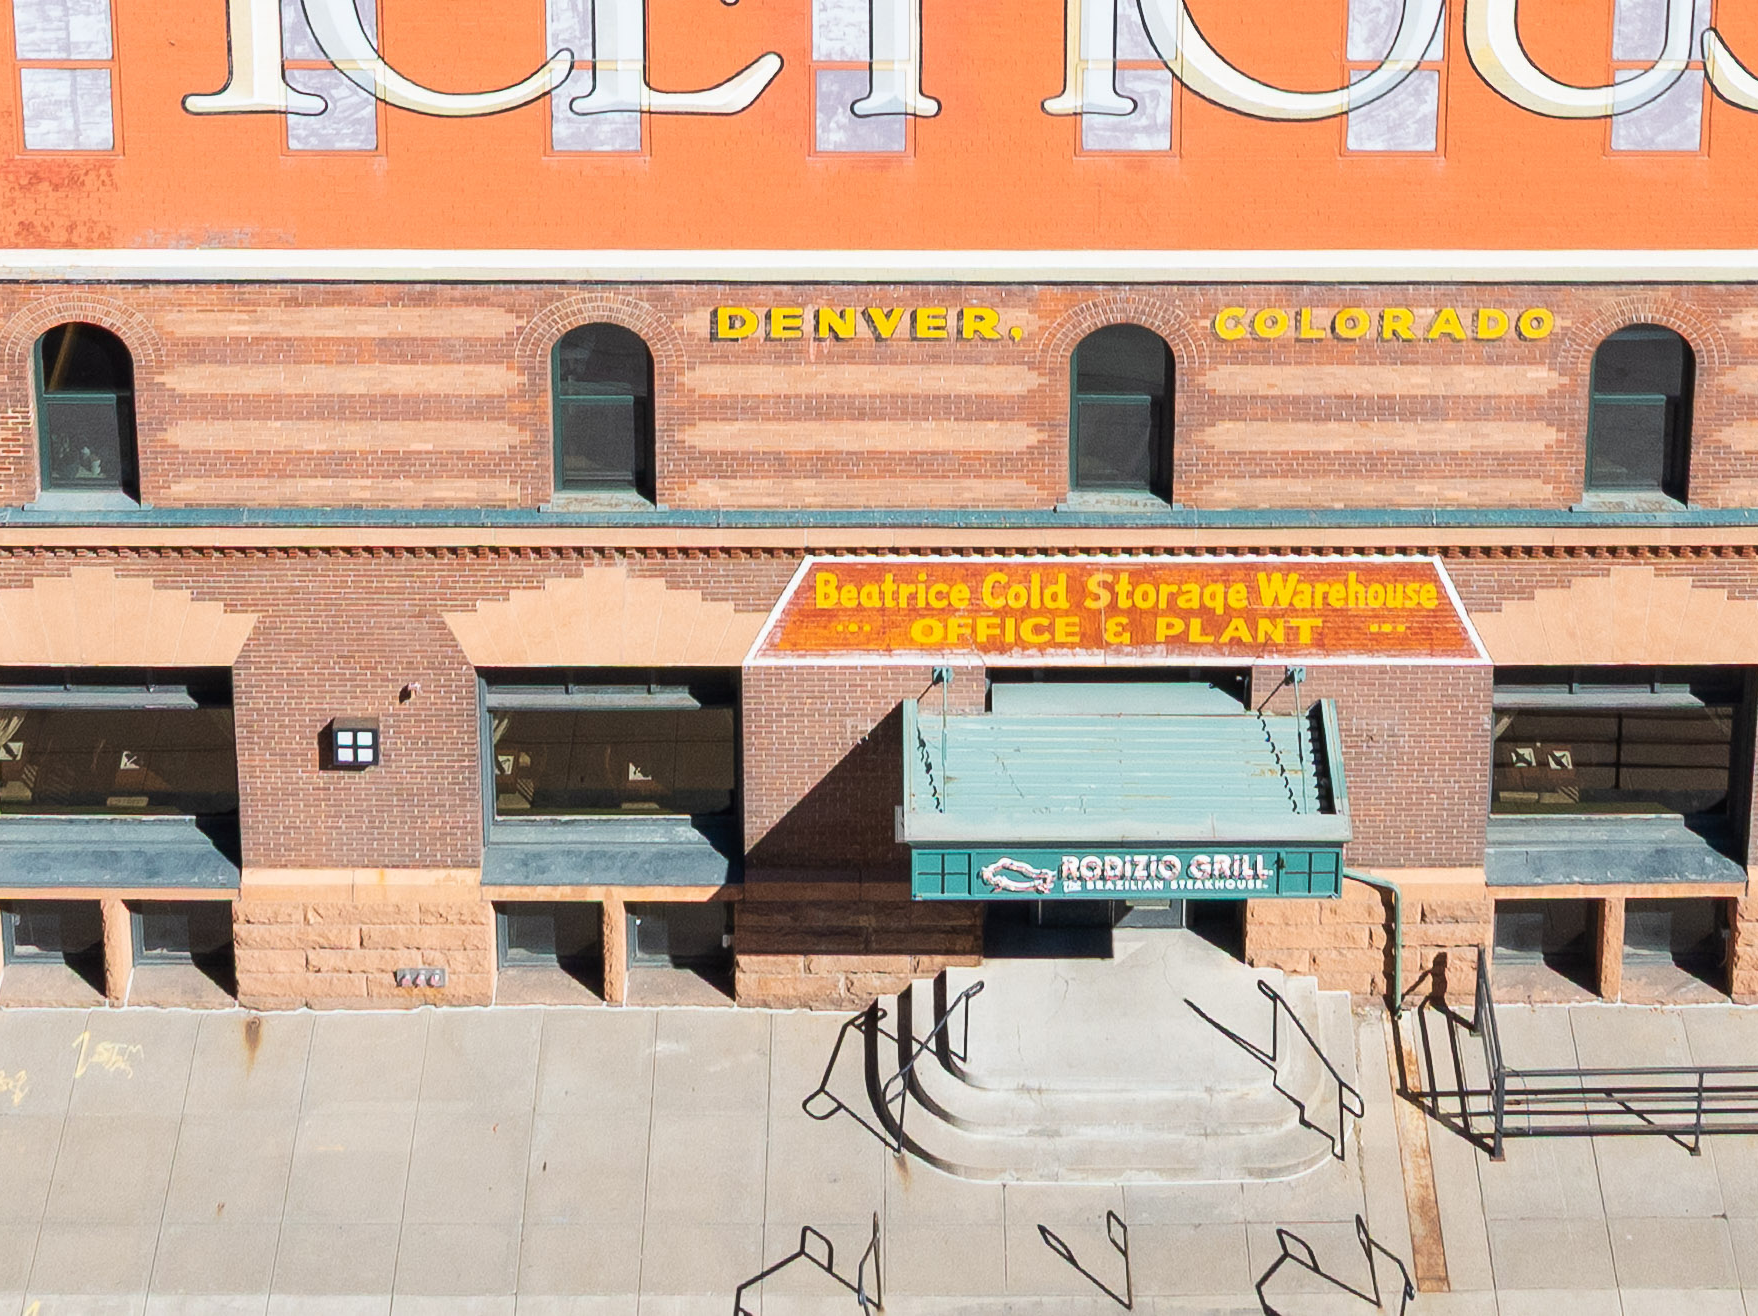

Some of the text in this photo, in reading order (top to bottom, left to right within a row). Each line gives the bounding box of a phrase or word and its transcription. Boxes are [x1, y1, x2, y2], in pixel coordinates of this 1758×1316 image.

[1213, 304, 1555, 342] COLORADO
[814, 571, 1439, 615] Beatrice Cold Storage Warehouse
[909, 617, 1323, 645] OFFICE & PLANT
[1086, 879, 1165, 891] BRAZILIAN
